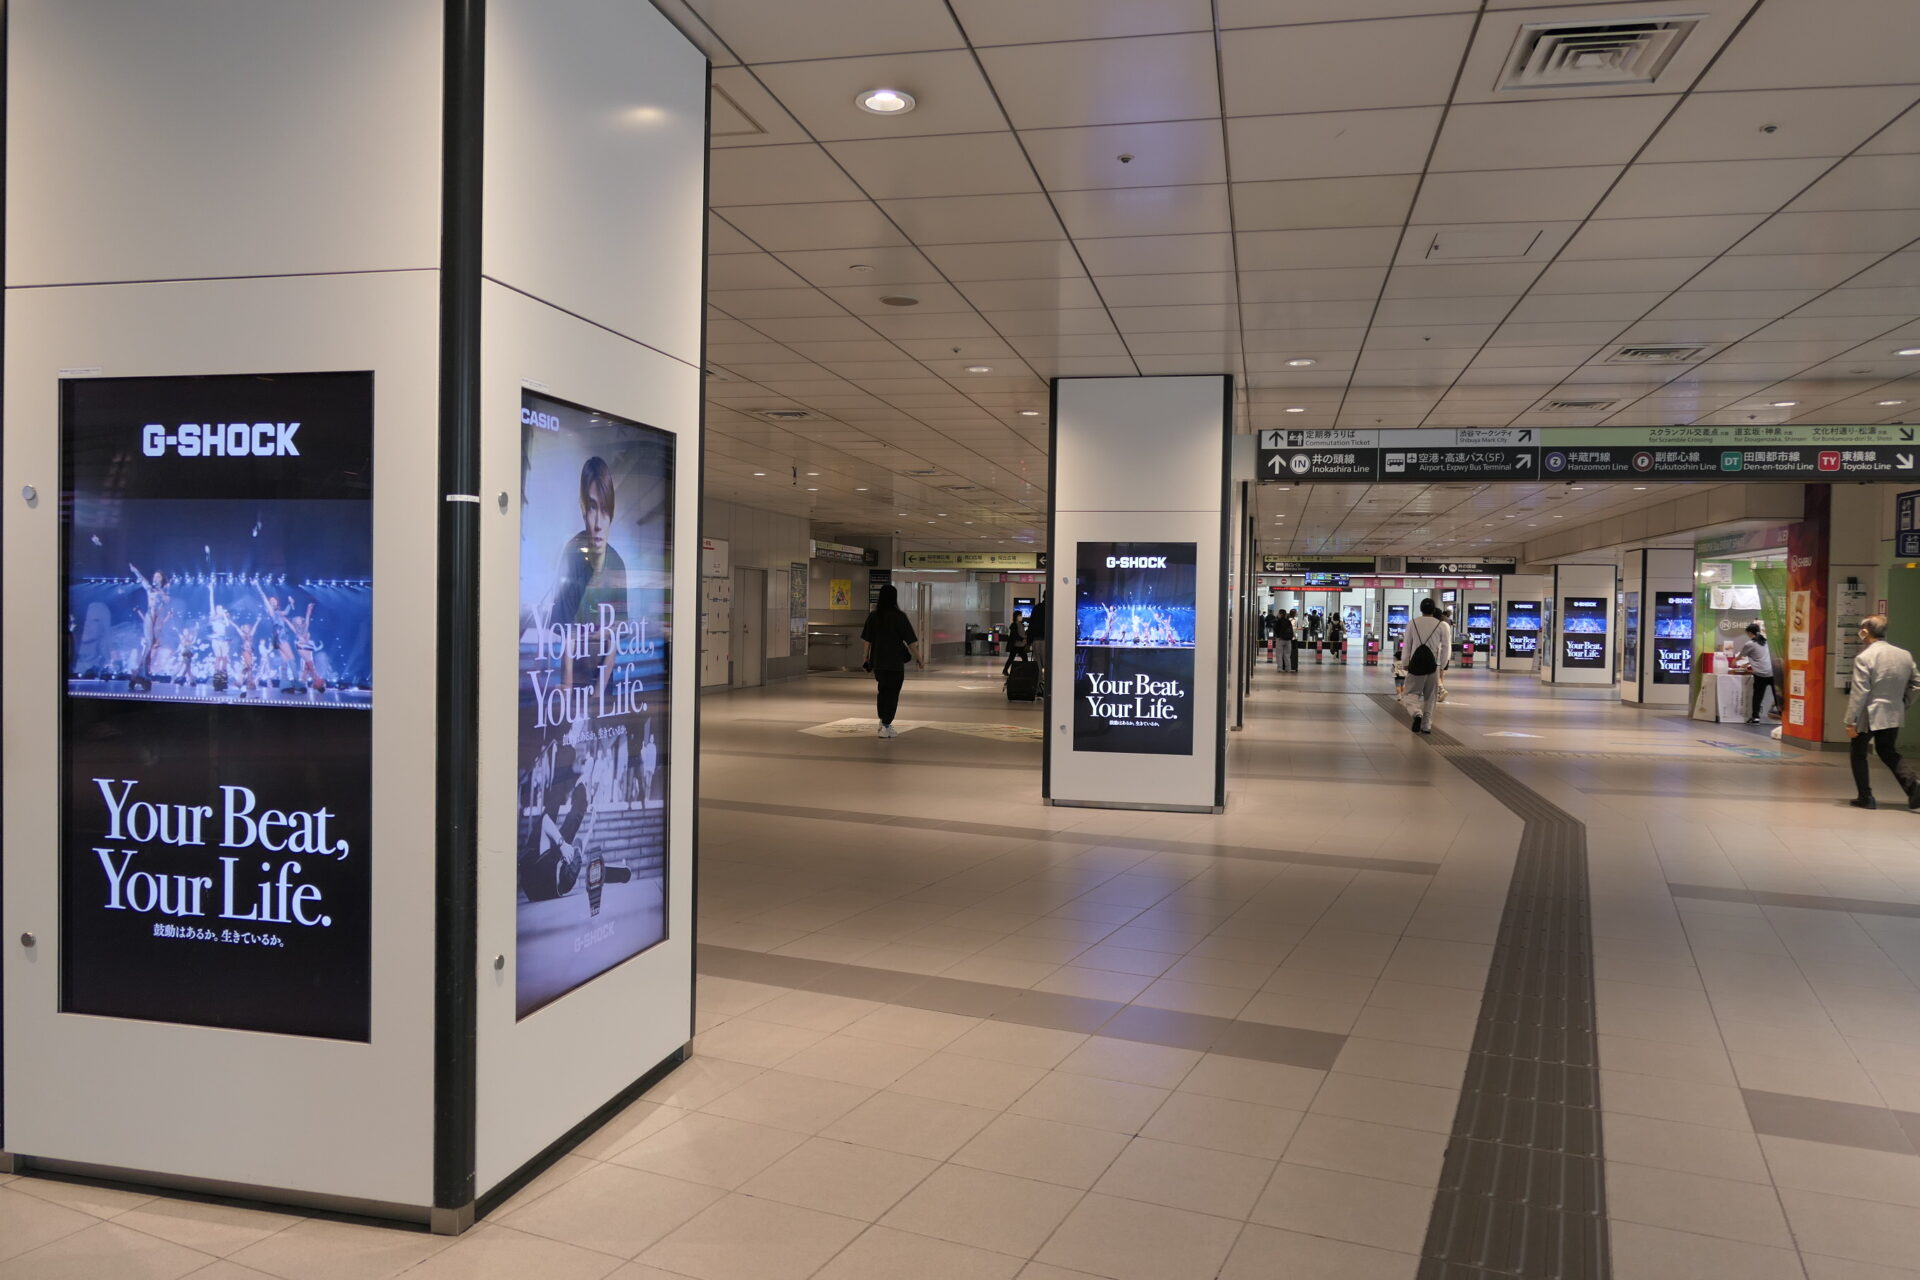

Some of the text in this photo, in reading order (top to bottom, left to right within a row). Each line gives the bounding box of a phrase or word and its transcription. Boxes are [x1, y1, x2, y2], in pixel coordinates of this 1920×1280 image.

[521, 408, 560, 431] CASIO
[1305, 430, 1355, 439] 定期券うりば
[1459, 429, 1513, 437] 渋谷マークシティ
[143, 423, 300, 457] G-SHOCK
[1312, 454, 1355, 465] 井の頭線
[1567, 452, 1611, 462] 半蔵門線
[1655, 452, 1700, 462] 副都心線
[1744, 452, 1800, 462] 田園都市線
[1841, 451, 1876, 461] 東横線
[1294, 460, 1306, 468] IN
[1724, 457, 1739, 466] DT
[1743, 462, 1814, 471] Den-en-toshi Line
[1822, 457, 1837, 466] TY
[1312, 465, 1370, 473] Inokashira Line
[1419, 462, 1512, 472] Airport, Expwy Bus Terminal
[1567, 463, 1628, 471] Hanzomon Line
[1655, 463, 1717, 471] Fukutoshin Line
[1842, 462, 1892, 472] Toyoko Line
[1106, 557, 1167, 569] G-SHOCK
[530, 602, 655, 661] Your Beat,
[1566, 641, 1584, 649] Your
[1566, 649, 1584, 657] Your
[1658, 649, 1682, 660] Your
[1658, 660, 1682, 670] Your
[1086, 672, 1185, 698] Your Beat,
[526, 662, 648, 728] Your Life.
[1086, 696, 1178, 719] Your Life.
[92, 777, 350, 861] Your Beat,
[92, 847, 332, 927] Your Life.
[153, 922, 284, 948] 鼓動はあるか。生きているか。
[574, 920, 616, 953] G-SHOCK
